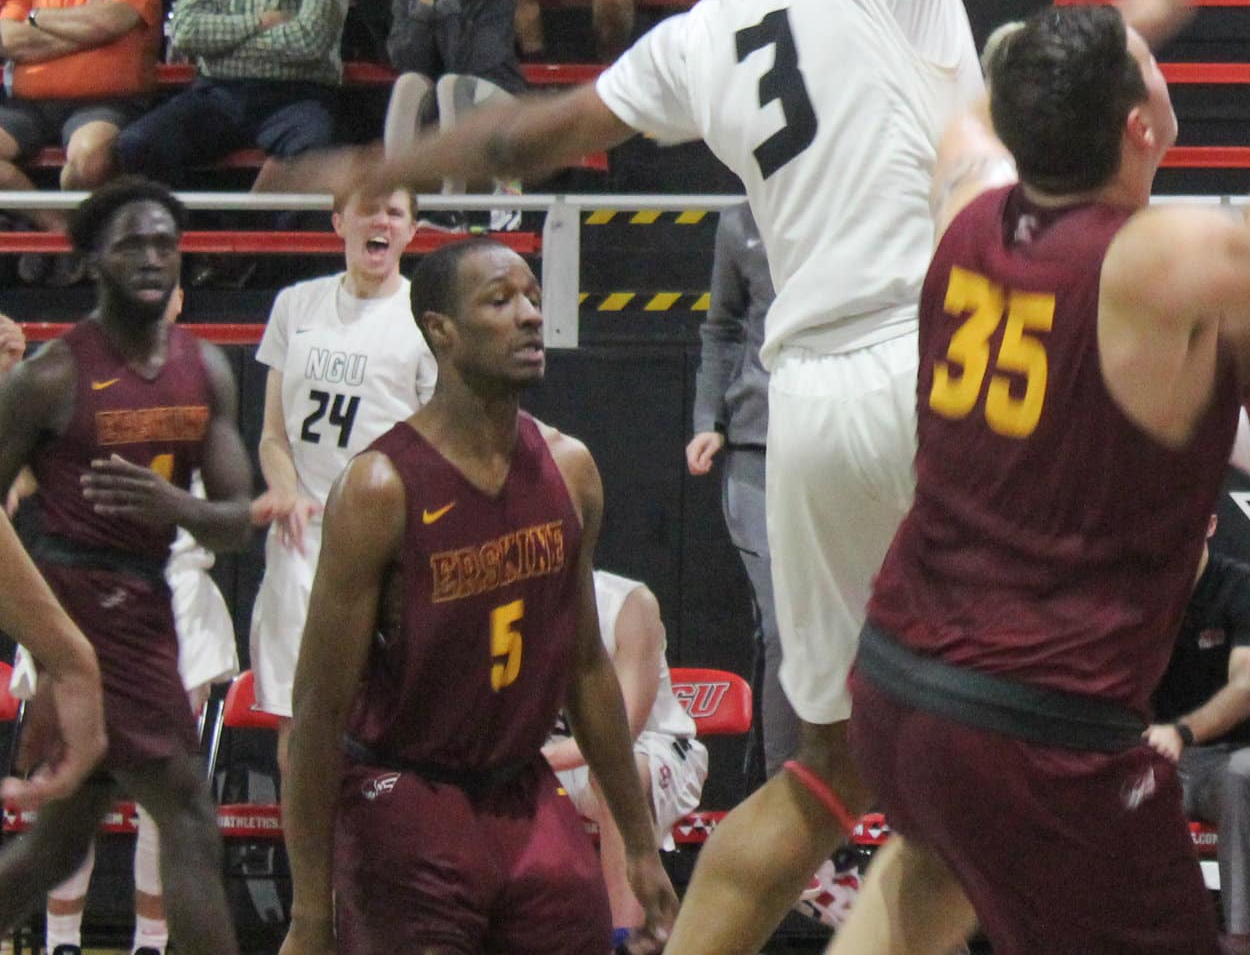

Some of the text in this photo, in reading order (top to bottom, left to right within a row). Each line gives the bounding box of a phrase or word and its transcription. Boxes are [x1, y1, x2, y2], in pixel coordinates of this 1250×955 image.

[735, 8, 818, 181] 3
[305, 347, 367, 386] NGU
[929, 265, 1056, 438] 35
[301, 389, 361, 448] 24
[430, 519, 565, 603] ERSKINE
[490, 599, 525, 693] 5
[672, 682, 731, 718] GU
